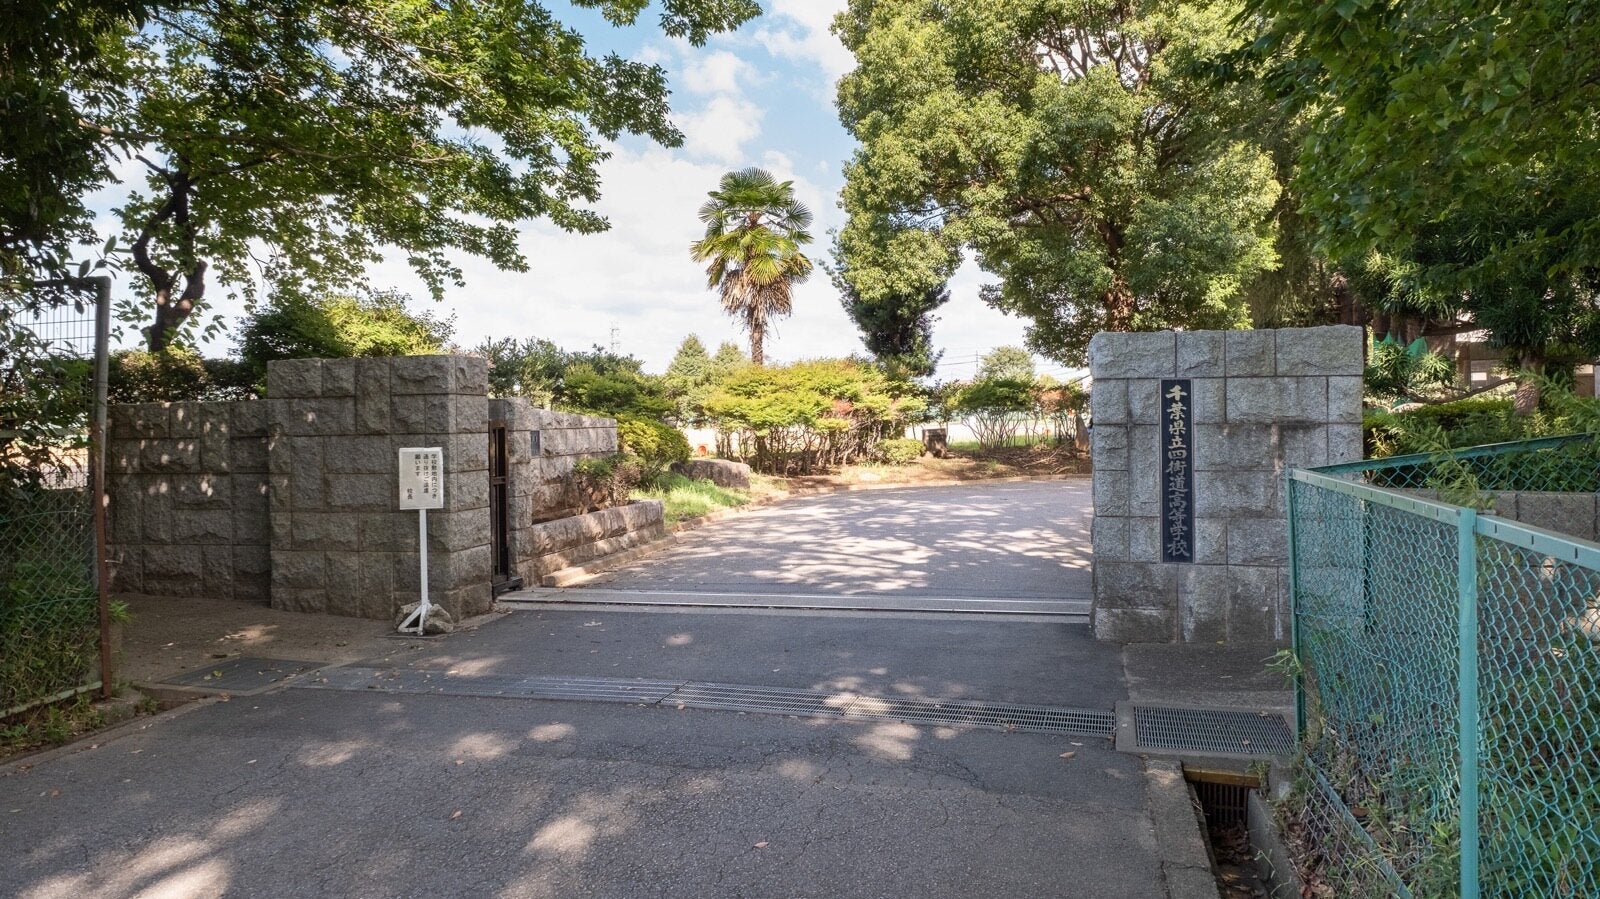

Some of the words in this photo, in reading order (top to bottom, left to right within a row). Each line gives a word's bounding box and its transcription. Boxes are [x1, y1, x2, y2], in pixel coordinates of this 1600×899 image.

[1165, 384, 1190, 557] 千葉県立四街道高等学校
